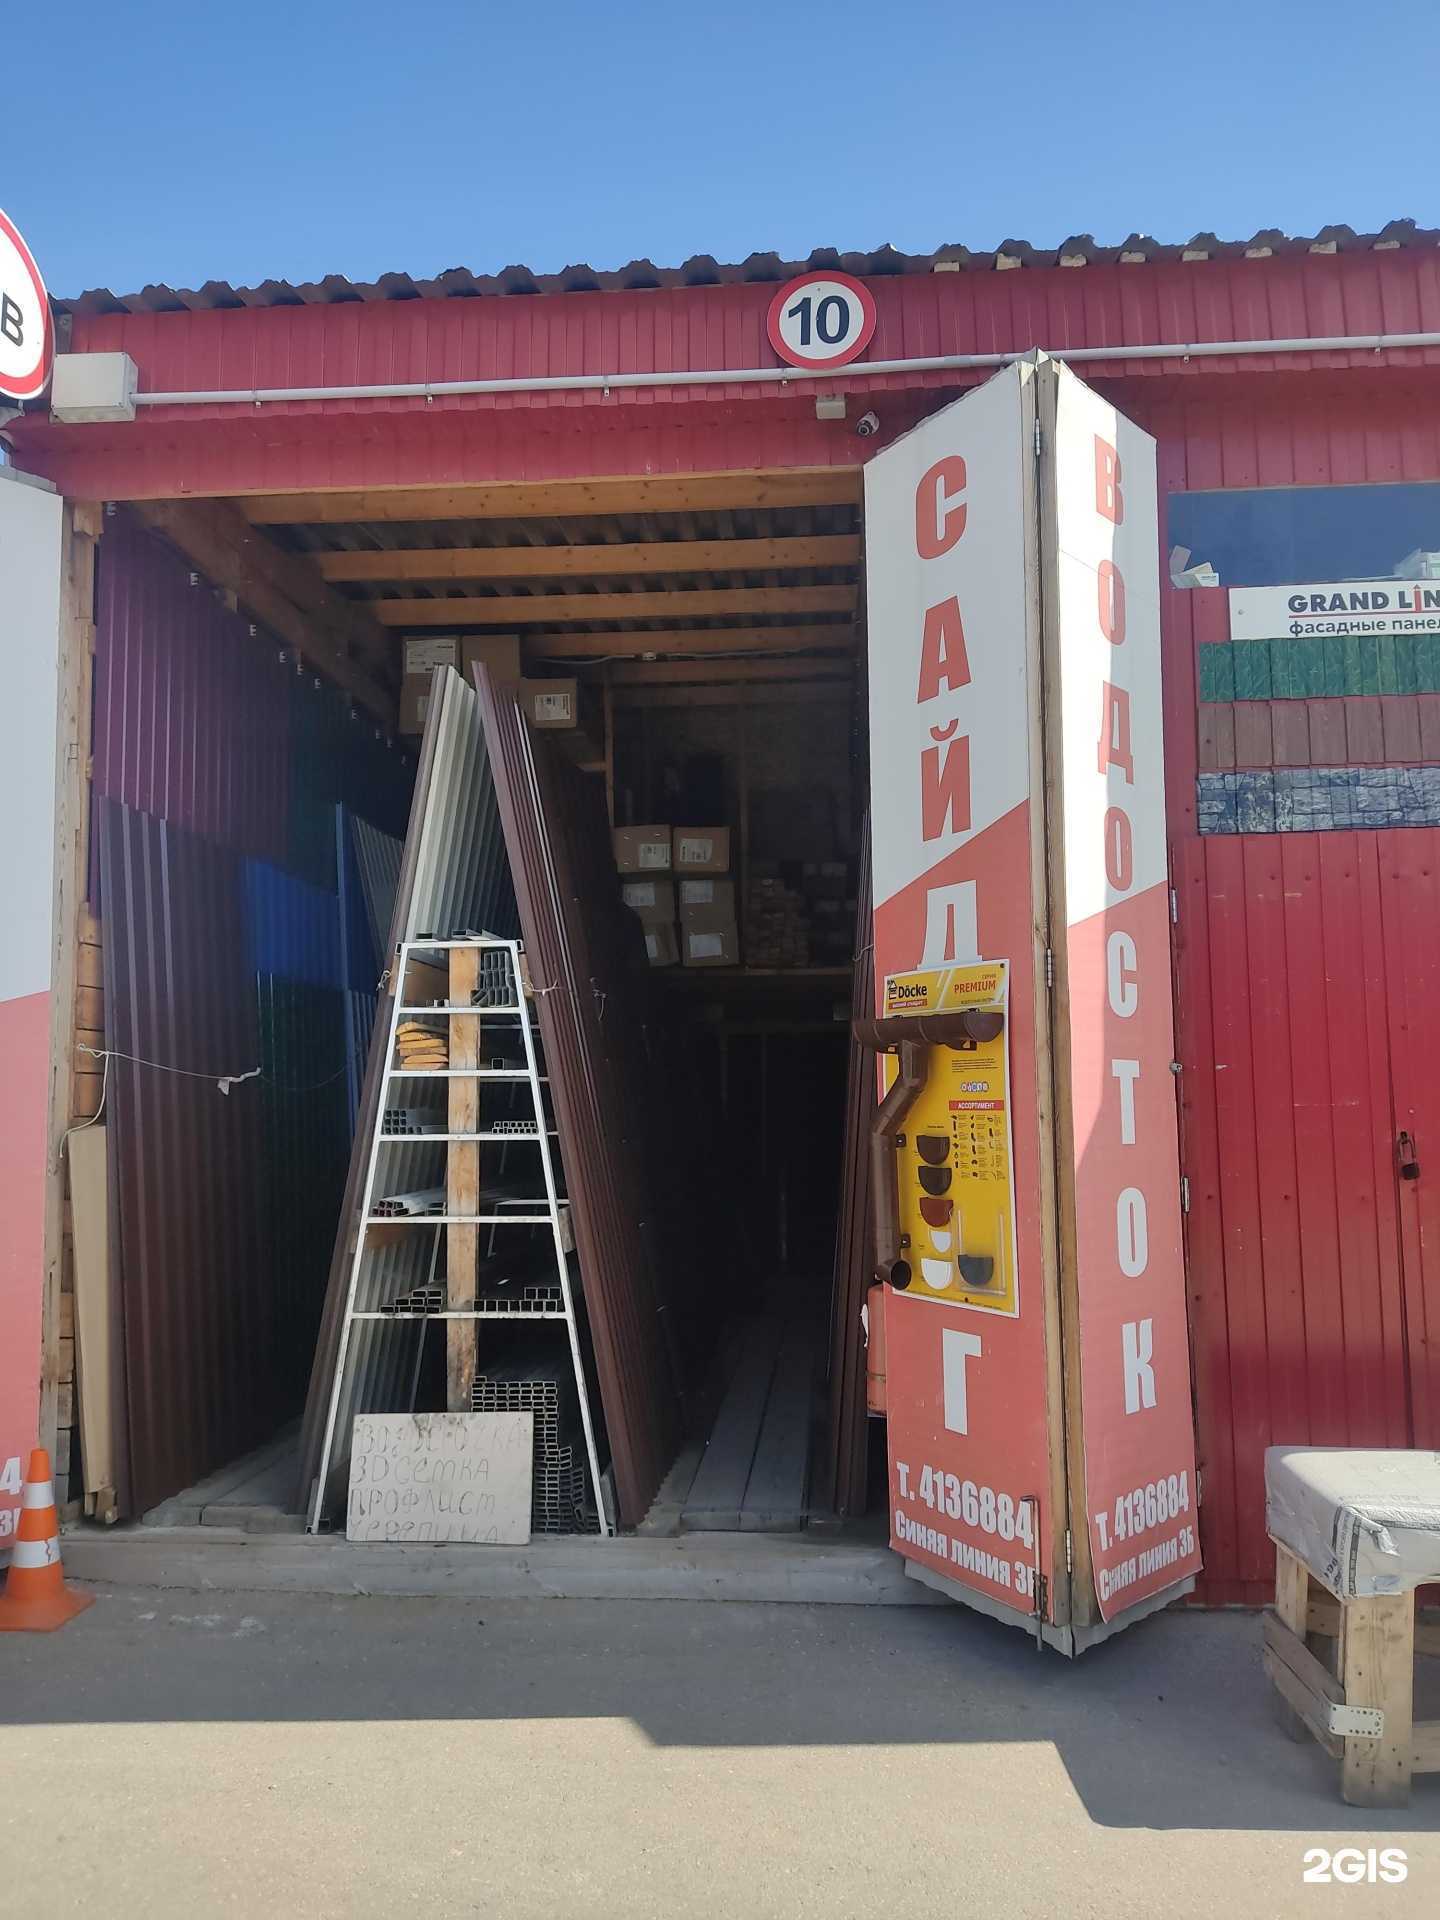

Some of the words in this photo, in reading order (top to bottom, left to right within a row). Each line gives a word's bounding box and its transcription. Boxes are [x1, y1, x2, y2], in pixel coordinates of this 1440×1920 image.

[787, 295, 850, 345] 10
[1287, 591, 1390, 613] GRAND
[1289, 619, 1387, 637] фасадные
[915, 455, 984, 1436] САЙДГ
[1094, 433, 1157, 1415] ВОДОСТОК
[898, 984, 928, 999] Döcke
[954, 980, 997, 993] PREMIUM
[919, 1464, 1034, 1551] 4136884
[1115, 1470, 1189, 1541] 4136884
[1179, 1525, 1195, 1559] 3Б
